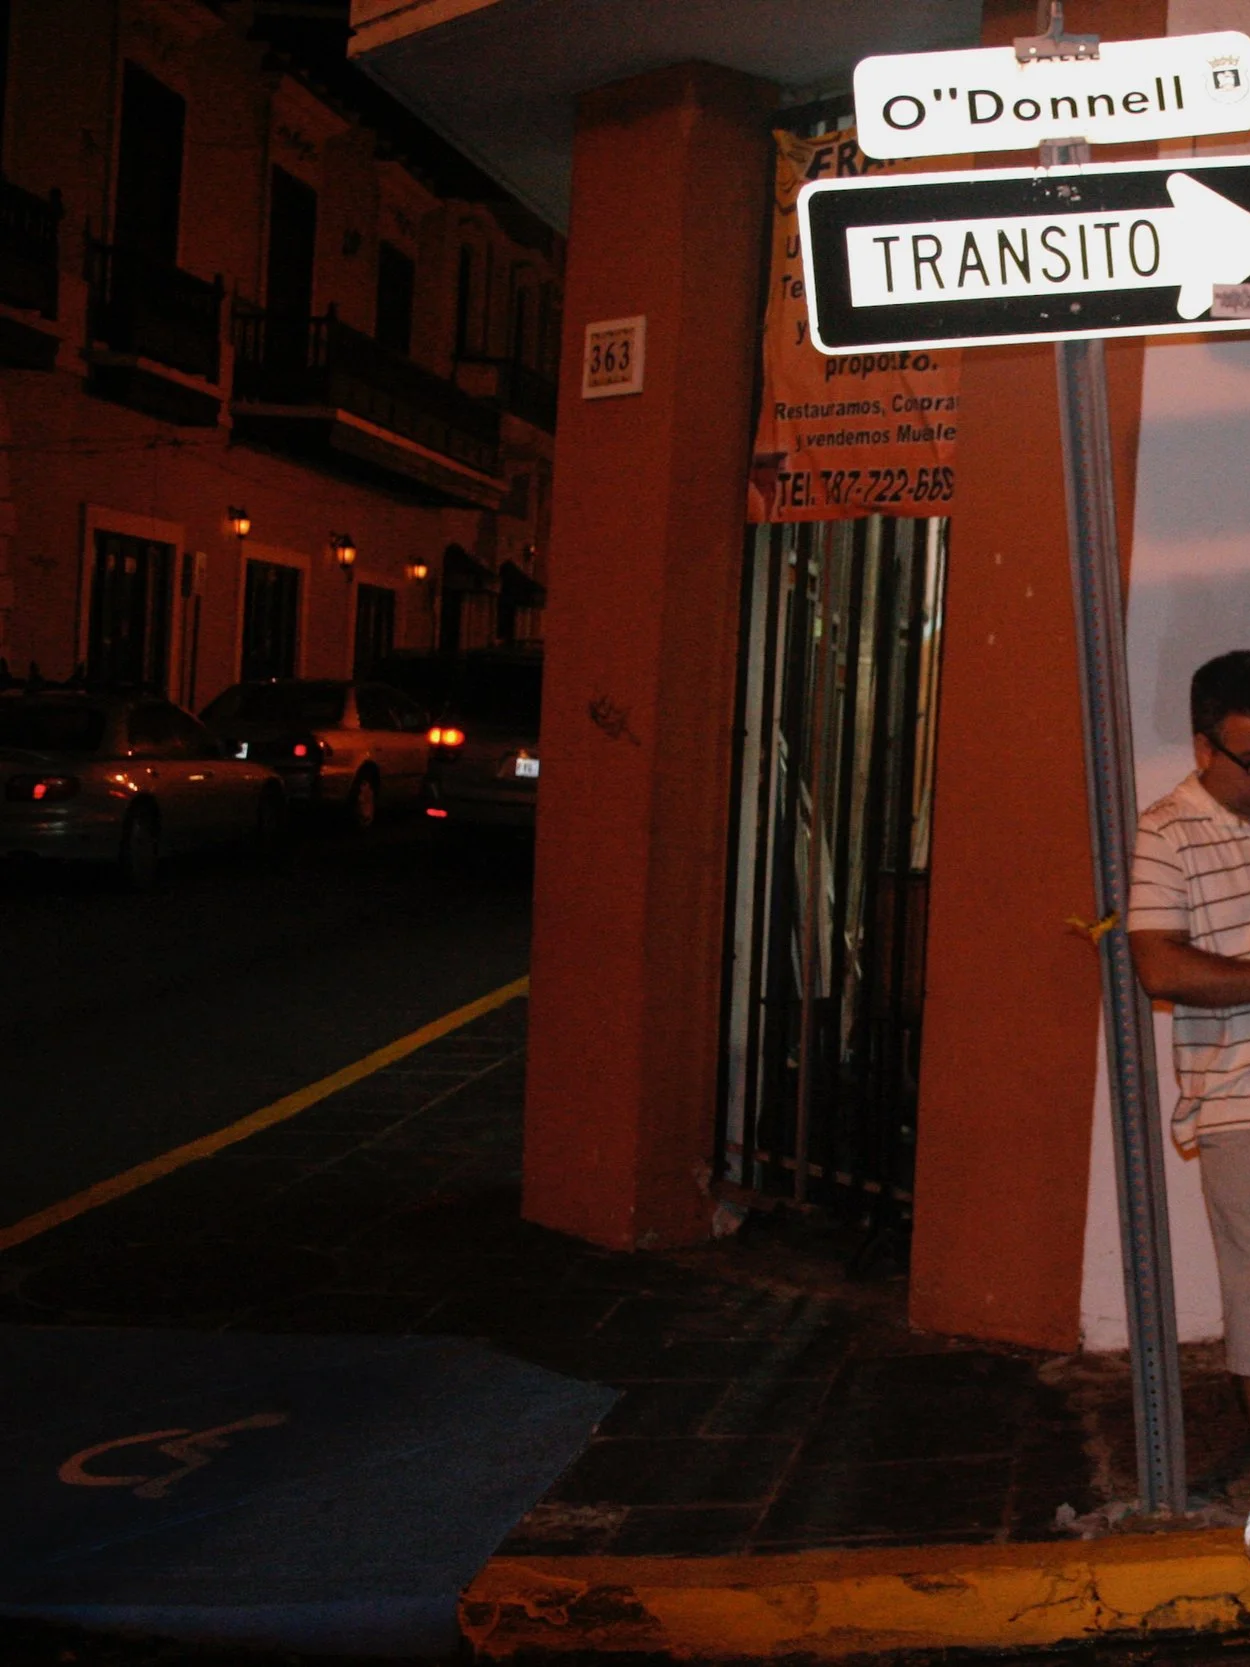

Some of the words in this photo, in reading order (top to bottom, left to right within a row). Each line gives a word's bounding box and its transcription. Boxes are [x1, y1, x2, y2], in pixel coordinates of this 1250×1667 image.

[882, 75, 1184, 130] O"Donnell
[872, 219, 1160, 292] TRANSITO
[590, 340, 630, 375] 363
[774, 400, 886, 420] Restauramos,
[806, 427, 890, 446] vendemos
